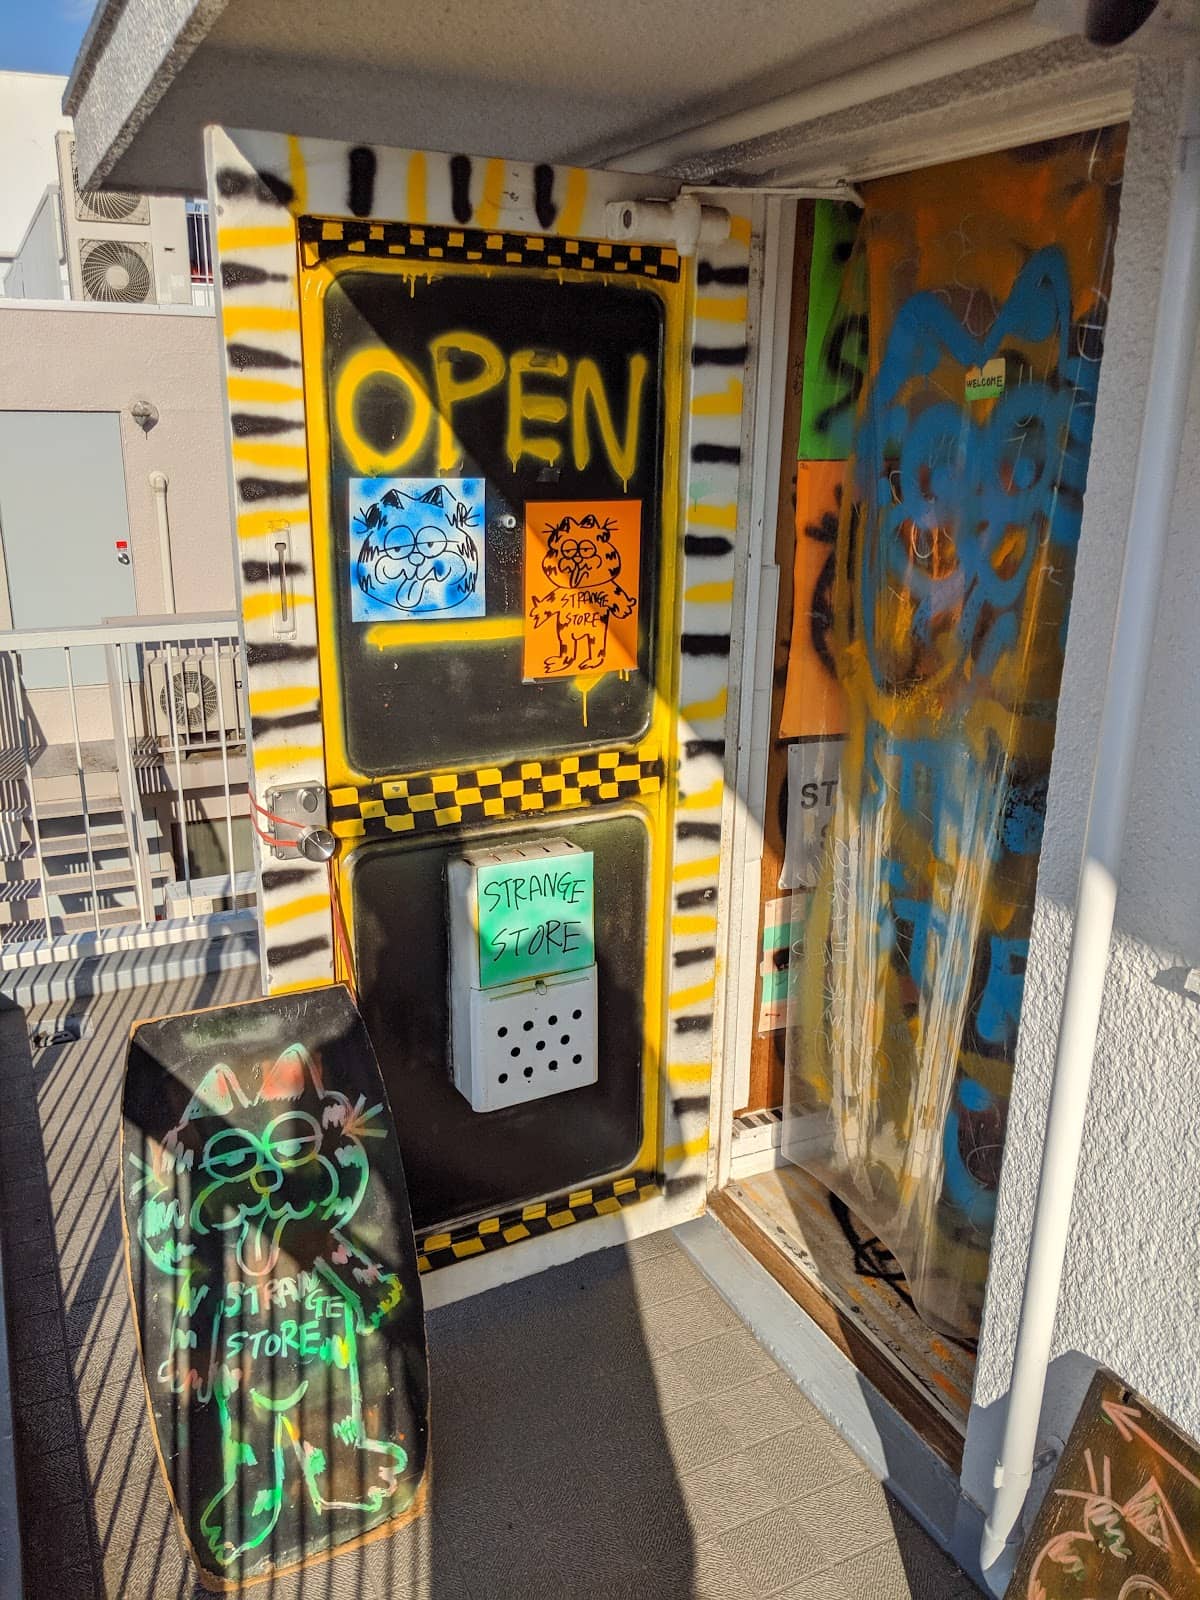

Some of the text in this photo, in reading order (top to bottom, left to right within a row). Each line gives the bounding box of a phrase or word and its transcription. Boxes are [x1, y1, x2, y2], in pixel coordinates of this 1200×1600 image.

[967, 376, 1003, 388] WELCOME
[336, 331, 647, 481] OPEN
[560, 590, 609, 608] STRANGE
[565, 611, 601, 628] STORE
[484, 871, 586, 912] STRANGE
[490, 919, 582, 962] STORE
[225, 1319, 321, 1360] STORE
